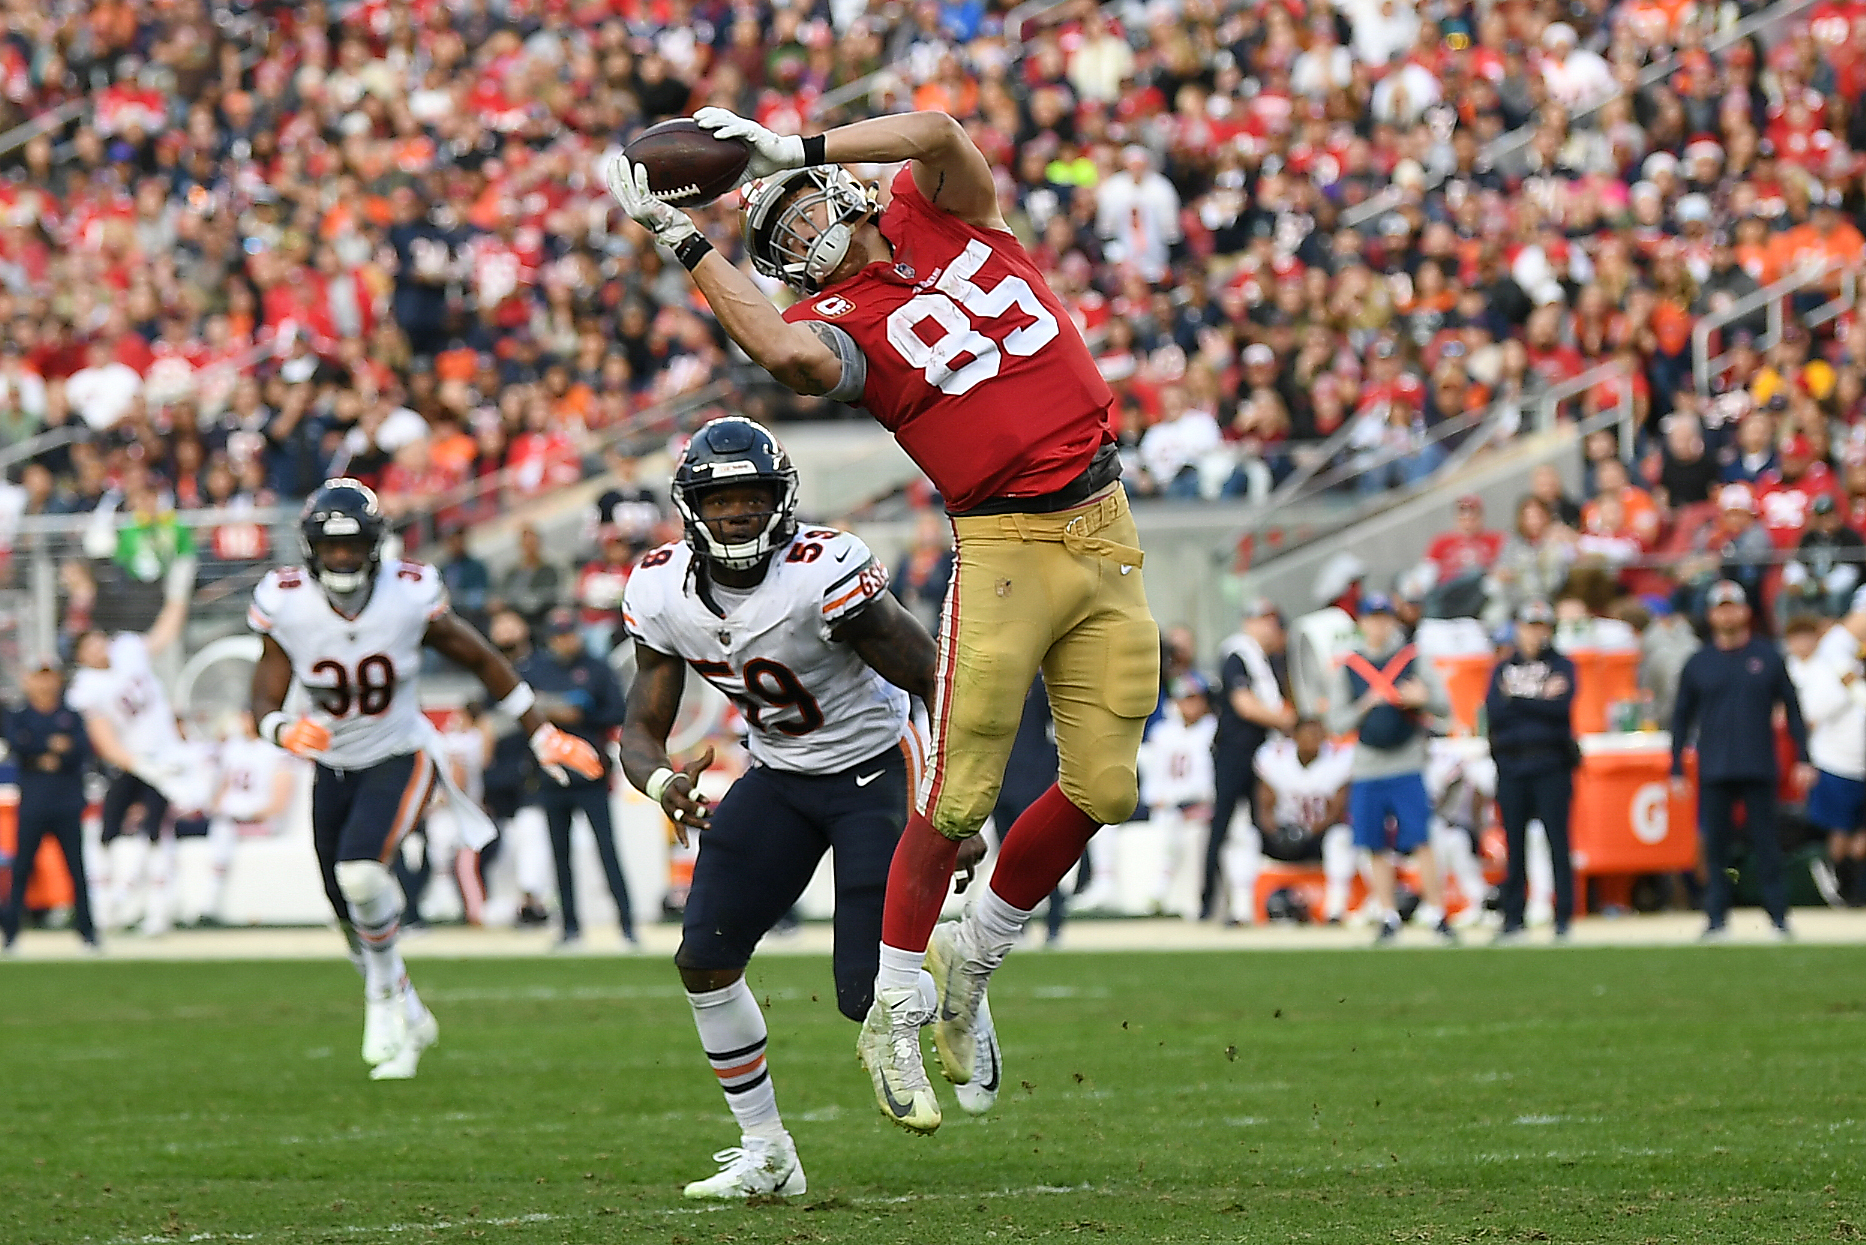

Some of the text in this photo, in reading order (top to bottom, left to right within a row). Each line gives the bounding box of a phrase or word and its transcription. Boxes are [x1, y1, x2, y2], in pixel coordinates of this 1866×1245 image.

[887, 238, 1060, 396] 85
[312, 653, 395, 719] 38
[687, 657, 825, 736] 59
[1628, 781, 1670, 845] G
